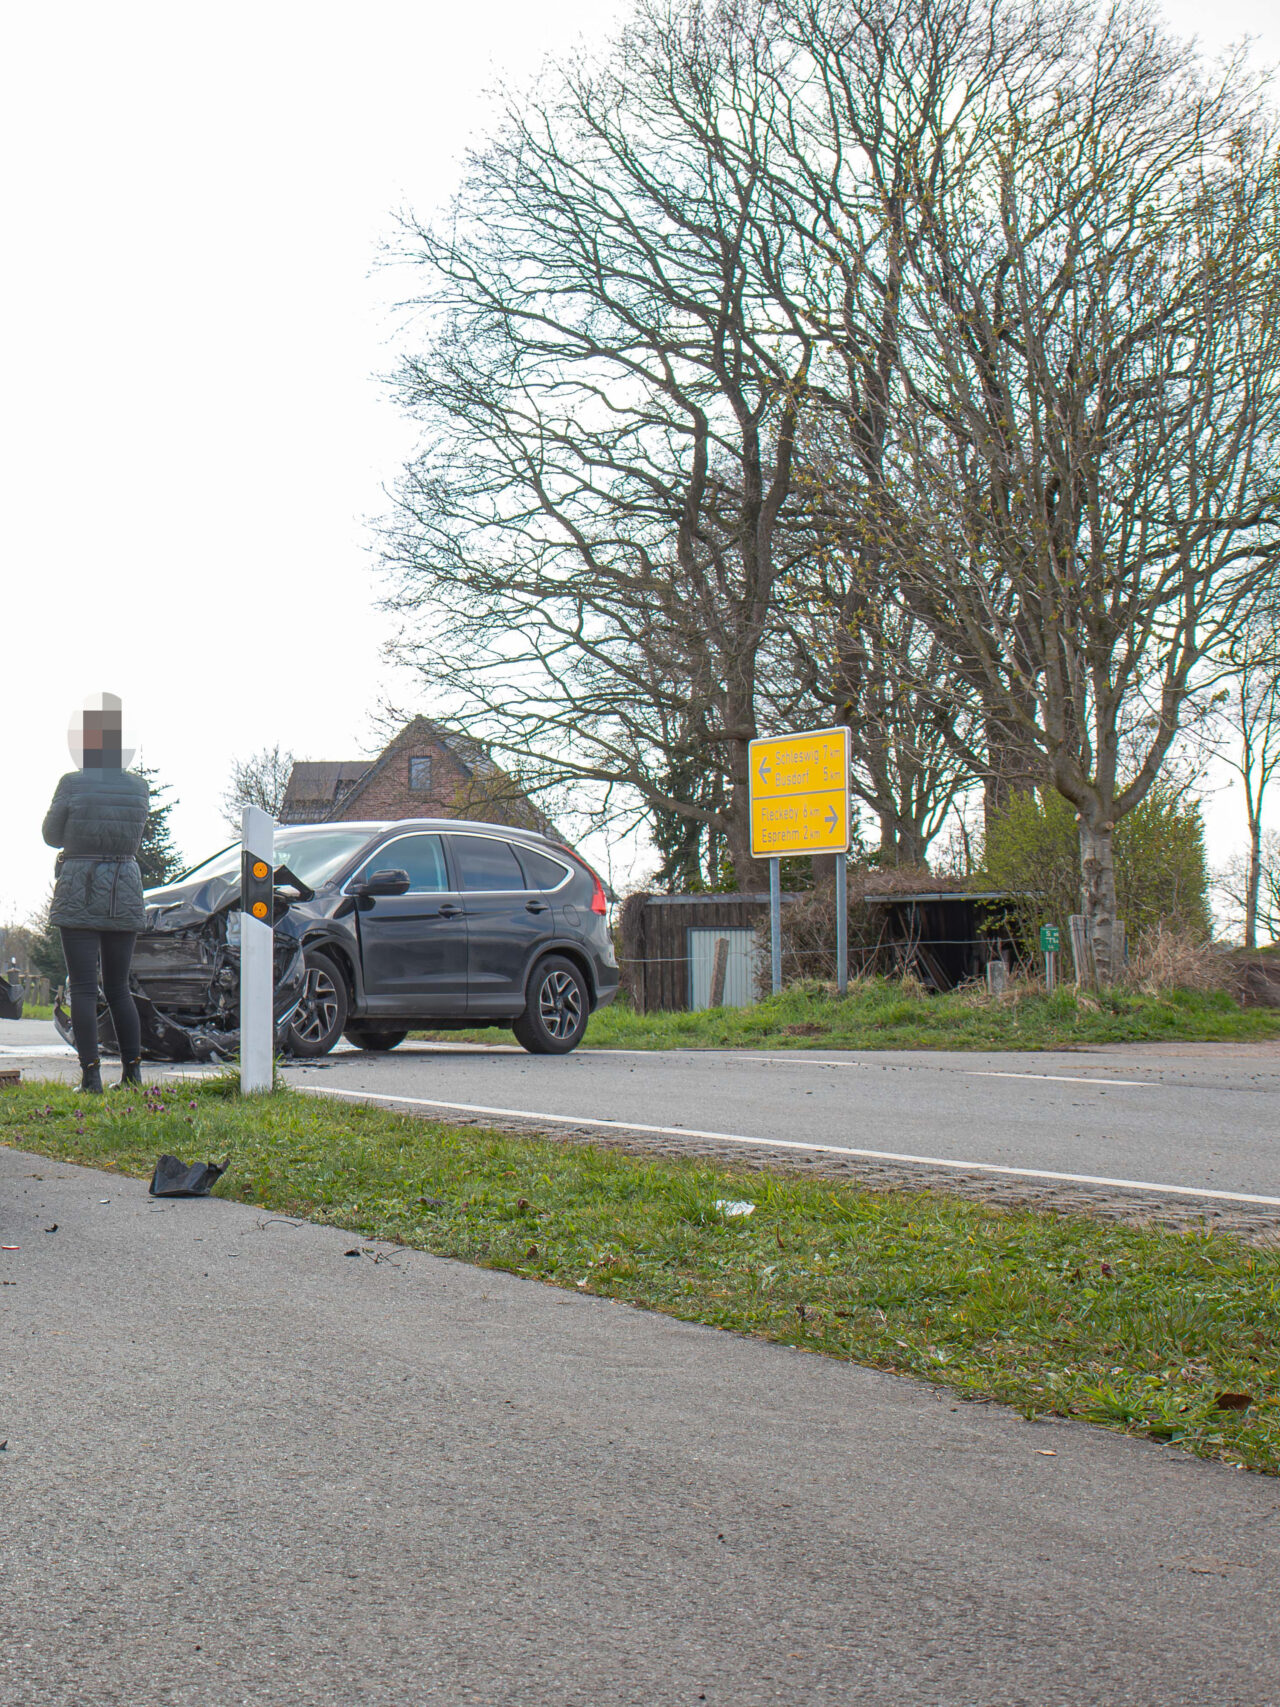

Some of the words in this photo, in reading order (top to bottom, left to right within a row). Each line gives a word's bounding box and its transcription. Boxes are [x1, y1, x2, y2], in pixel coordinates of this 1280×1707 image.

[775, 747, 819, 765] Schleswig
[822, 744, 828, 760] 7
[830, 747, 841, 759] km
[775, 768, 809, 787] Busdorf
[823, 766, 829, 782] 5
[830, 769, 841, 781] km
[761, 804, 799, 823] Fleckeby
[802, 803, 808, 819] 6
[810, 806, 821, 817] km
[761, 827, 800, 845] Esprehm
[803, 824, 809, 840] 2
[810, 828, 821, 839] km
